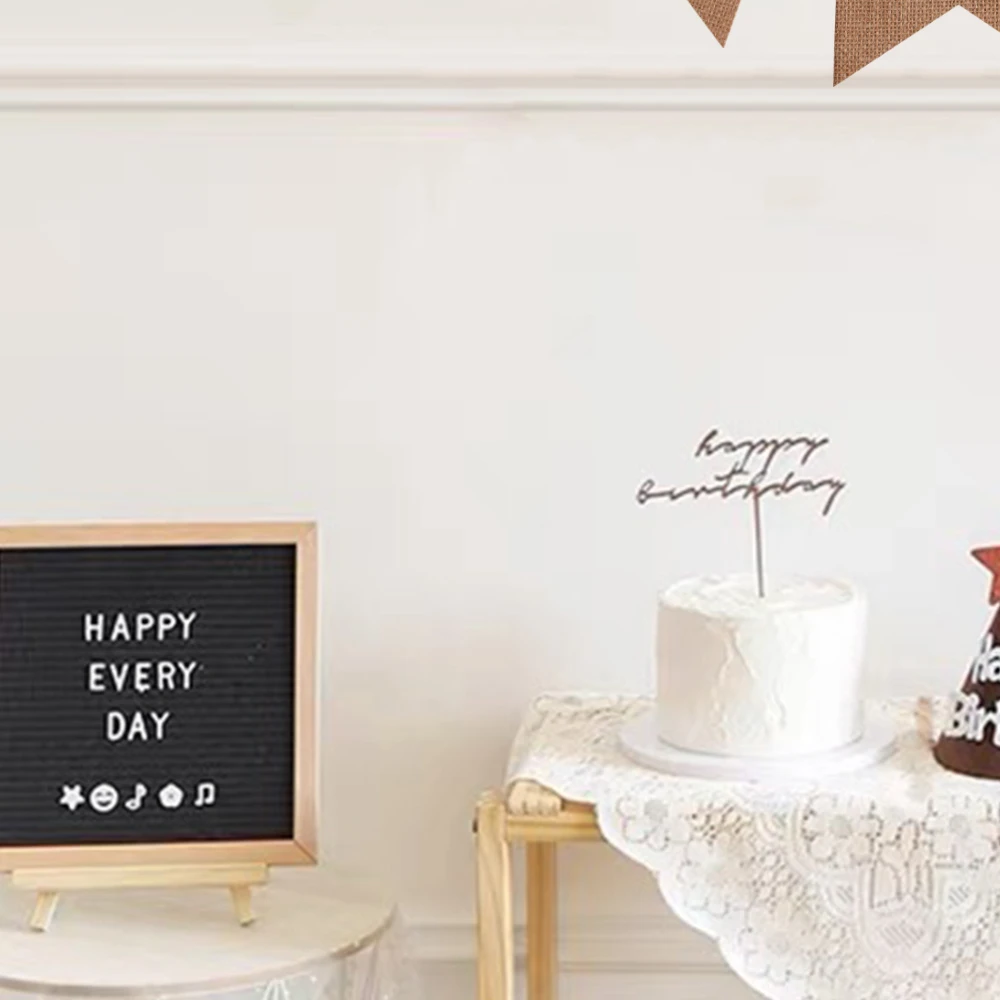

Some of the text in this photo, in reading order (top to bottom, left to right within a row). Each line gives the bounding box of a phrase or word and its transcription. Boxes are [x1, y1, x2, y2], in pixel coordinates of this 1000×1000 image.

[84, 611, 197, 642] HAPPY
[88, 661, 197, 693] EVERY
[106, 711, 170, 741] DAY
